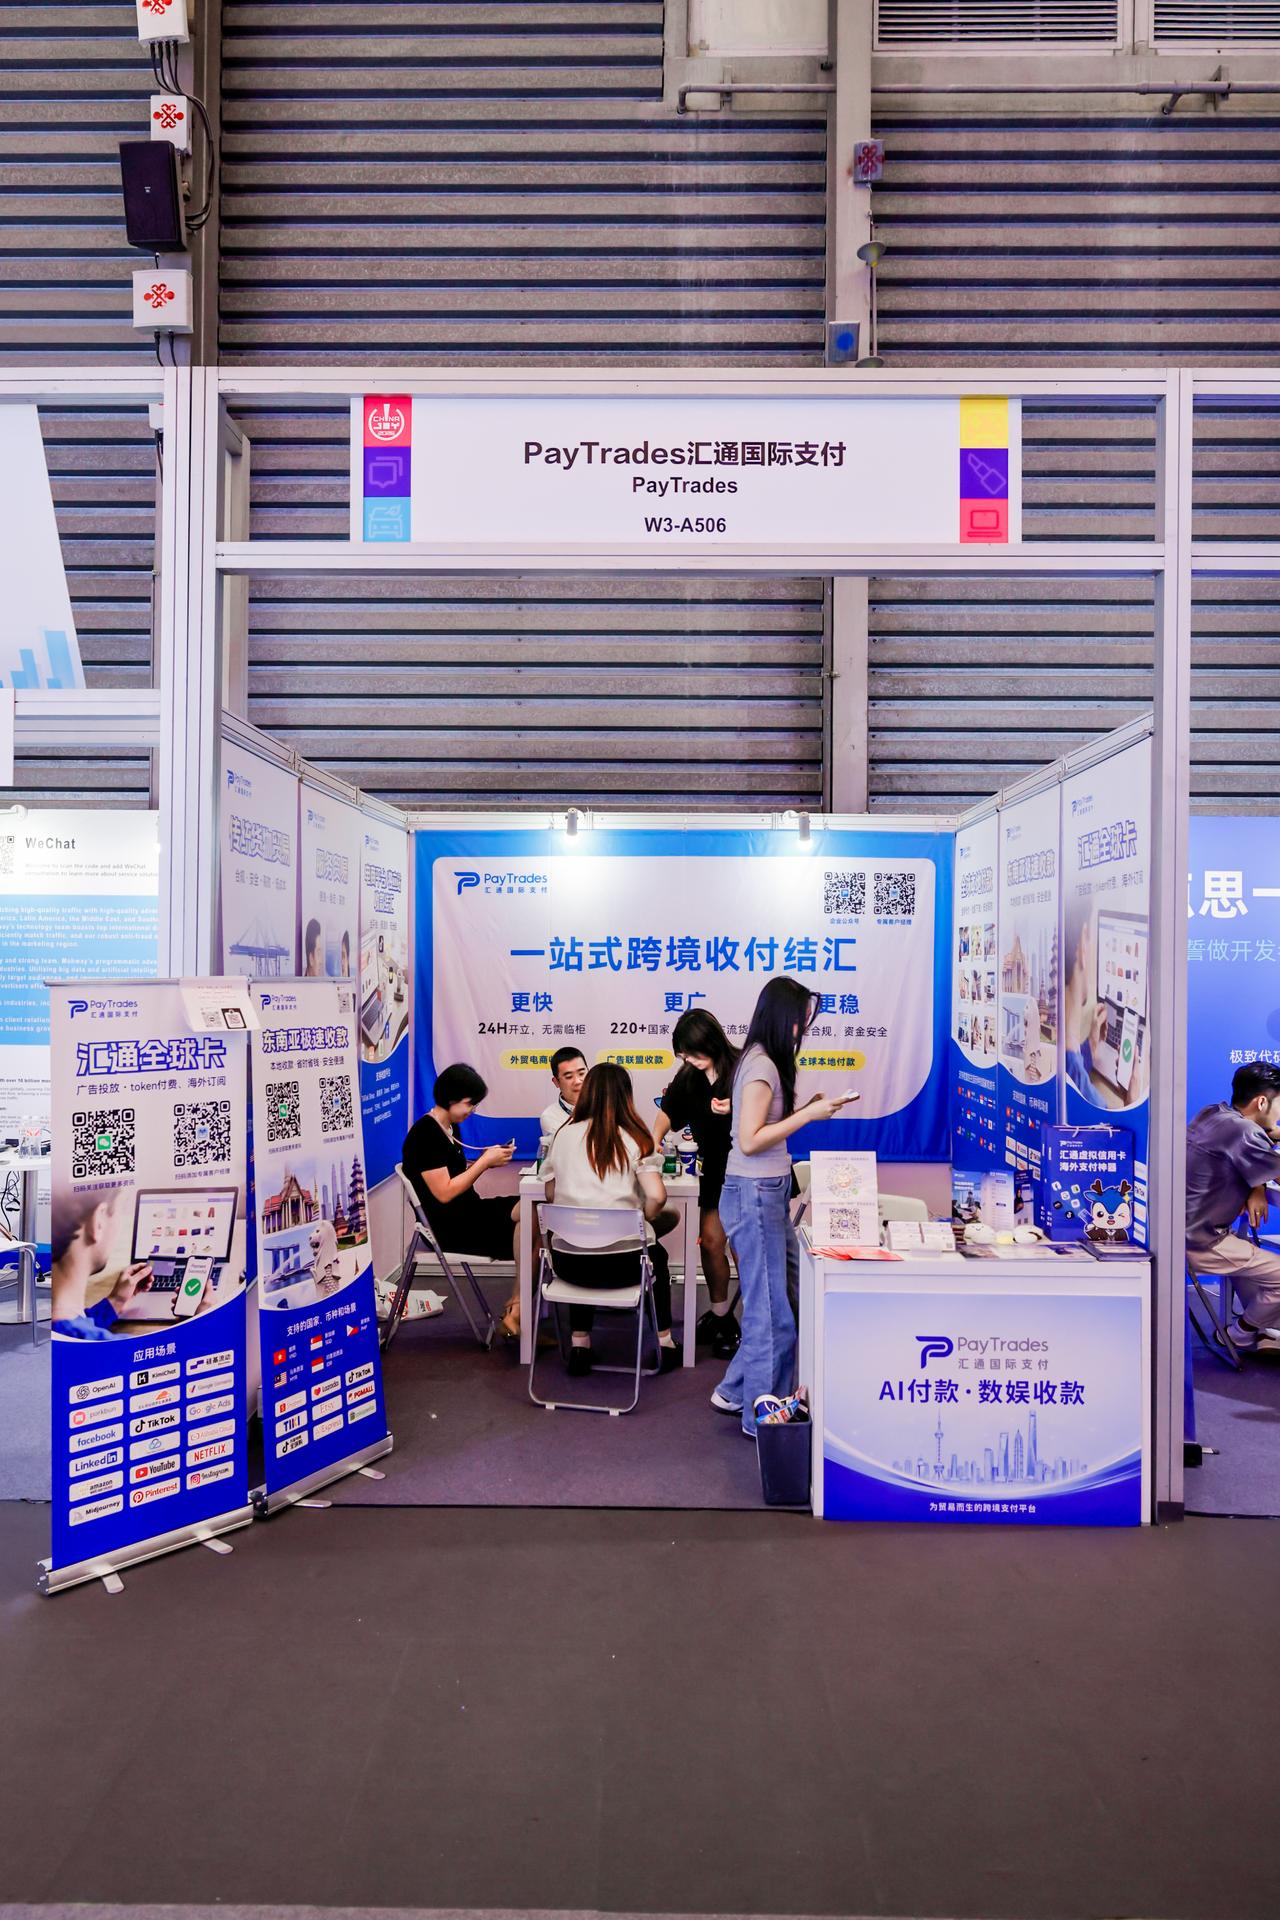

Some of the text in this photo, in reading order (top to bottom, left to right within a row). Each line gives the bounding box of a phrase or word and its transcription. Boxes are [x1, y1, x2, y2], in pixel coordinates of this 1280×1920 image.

[523, 441, 847, 468] PayTrades汇通国际支付
[631, 476, 738, 495] PayTrades
[643, 516, 727, 533] W3-A506
[25, 837, 76, 849] WeChat
[484, 873, 548, 886] PayTrades
[1187, 870, 1280, 919] 思一
[510, 935, 857, 973] 一站式跨境收付结汇
[1187, 939, 1280, 962] 誓做开发
[90, 1000, 138, 1010] PayTrades
[511, 992, 553, 1013] 更快
[664, 991, 706, 1012] 更广
[819, 993, 860, 1015] 更稳
[262, 1026, 349, 1054] 东南亚极速收款
[76, 1037, 227, 1077] 汇通全球卡
[606, 1054, 664, 1065] 广告联盟收款
[799, 1056, 856, 1067] 全球本地付款
[1059, 1150, 1127, 1160] 汇通虚拟信用卡
[133, 1342, 176, 1363] 应用场景
[958, 1336, 1049, 1354] PayTrades
[958, 1358, 1049, 1371] 汇通国际支付
[356, 1368, 370, 1378] TikTok
[92, 1382, 116, 1393] OpenAI
[147, 1414, 176, 1429] TikTok
[284, 1416, 300, 1432] TIKI
[77, 1430, 116, 1447] facebook
[194, 1444, 226, 1462] NETFLIX
[150, 1460, 176, 1475] YouTube
[202, 1467, 229, 1480] Instagram
[90, 1480, 113, 1491] amazon
[145, 1482, 178, 1499] Pinterest
[86, 1500, 120, 1515] Midjourney
[929, 1502, 1036, 1514] 为贸易而生的跨境支付平台
